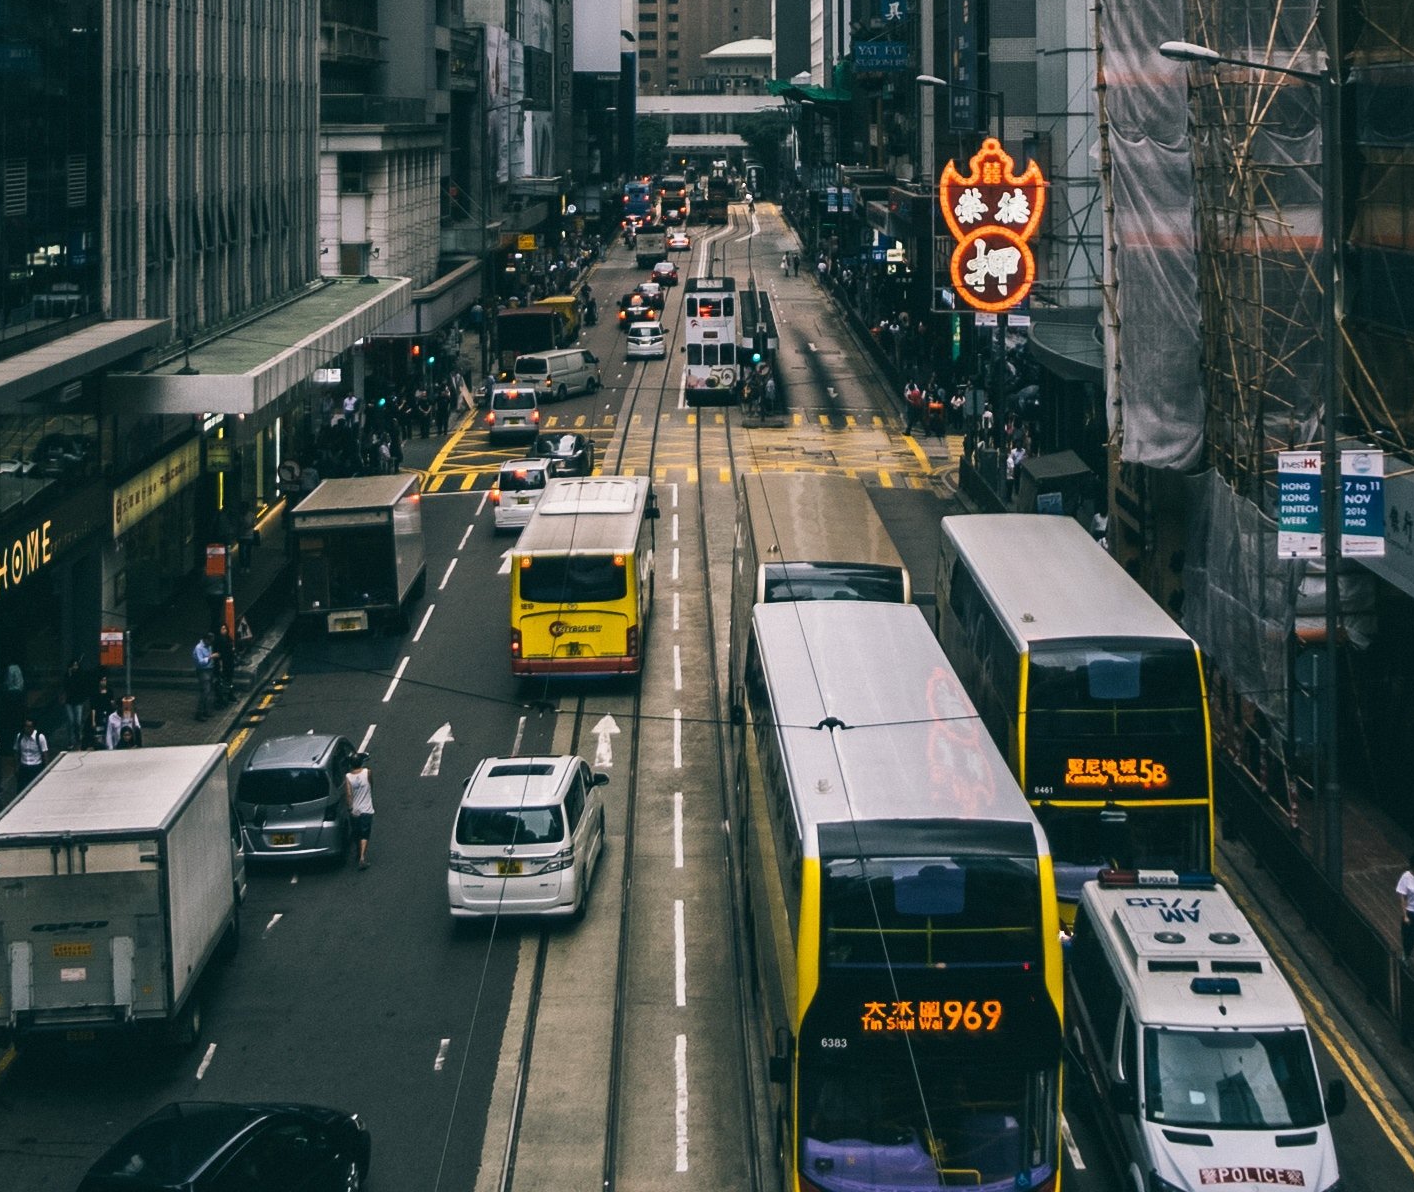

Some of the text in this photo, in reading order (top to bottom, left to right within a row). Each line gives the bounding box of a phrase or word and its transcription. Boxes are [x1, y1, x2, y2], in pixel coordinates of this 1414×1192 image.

[964, 238, 1022, 296] 押
[1281, 482, 1311, 491] HONG
[1345, 481, 1380, 492] 7 to 11
[1281, 494, 1310, 502] KONG
[1345, 494, 1371, 504] NOV
[1281, 505, 1318, 513] FINTECH
[1345, 507, 1367, 516] 2016
[1281, 517, 1308, 525] WEEK
[1139, 759, 1168, 784] 5B
[943, 1000, 1003, 1031] 969
[861, 1017, 943, 1031] Tin Shui Wai
[820, 1038, 848, 1048] 6383
[1217, 1168, 1287, 1184] POLICE
